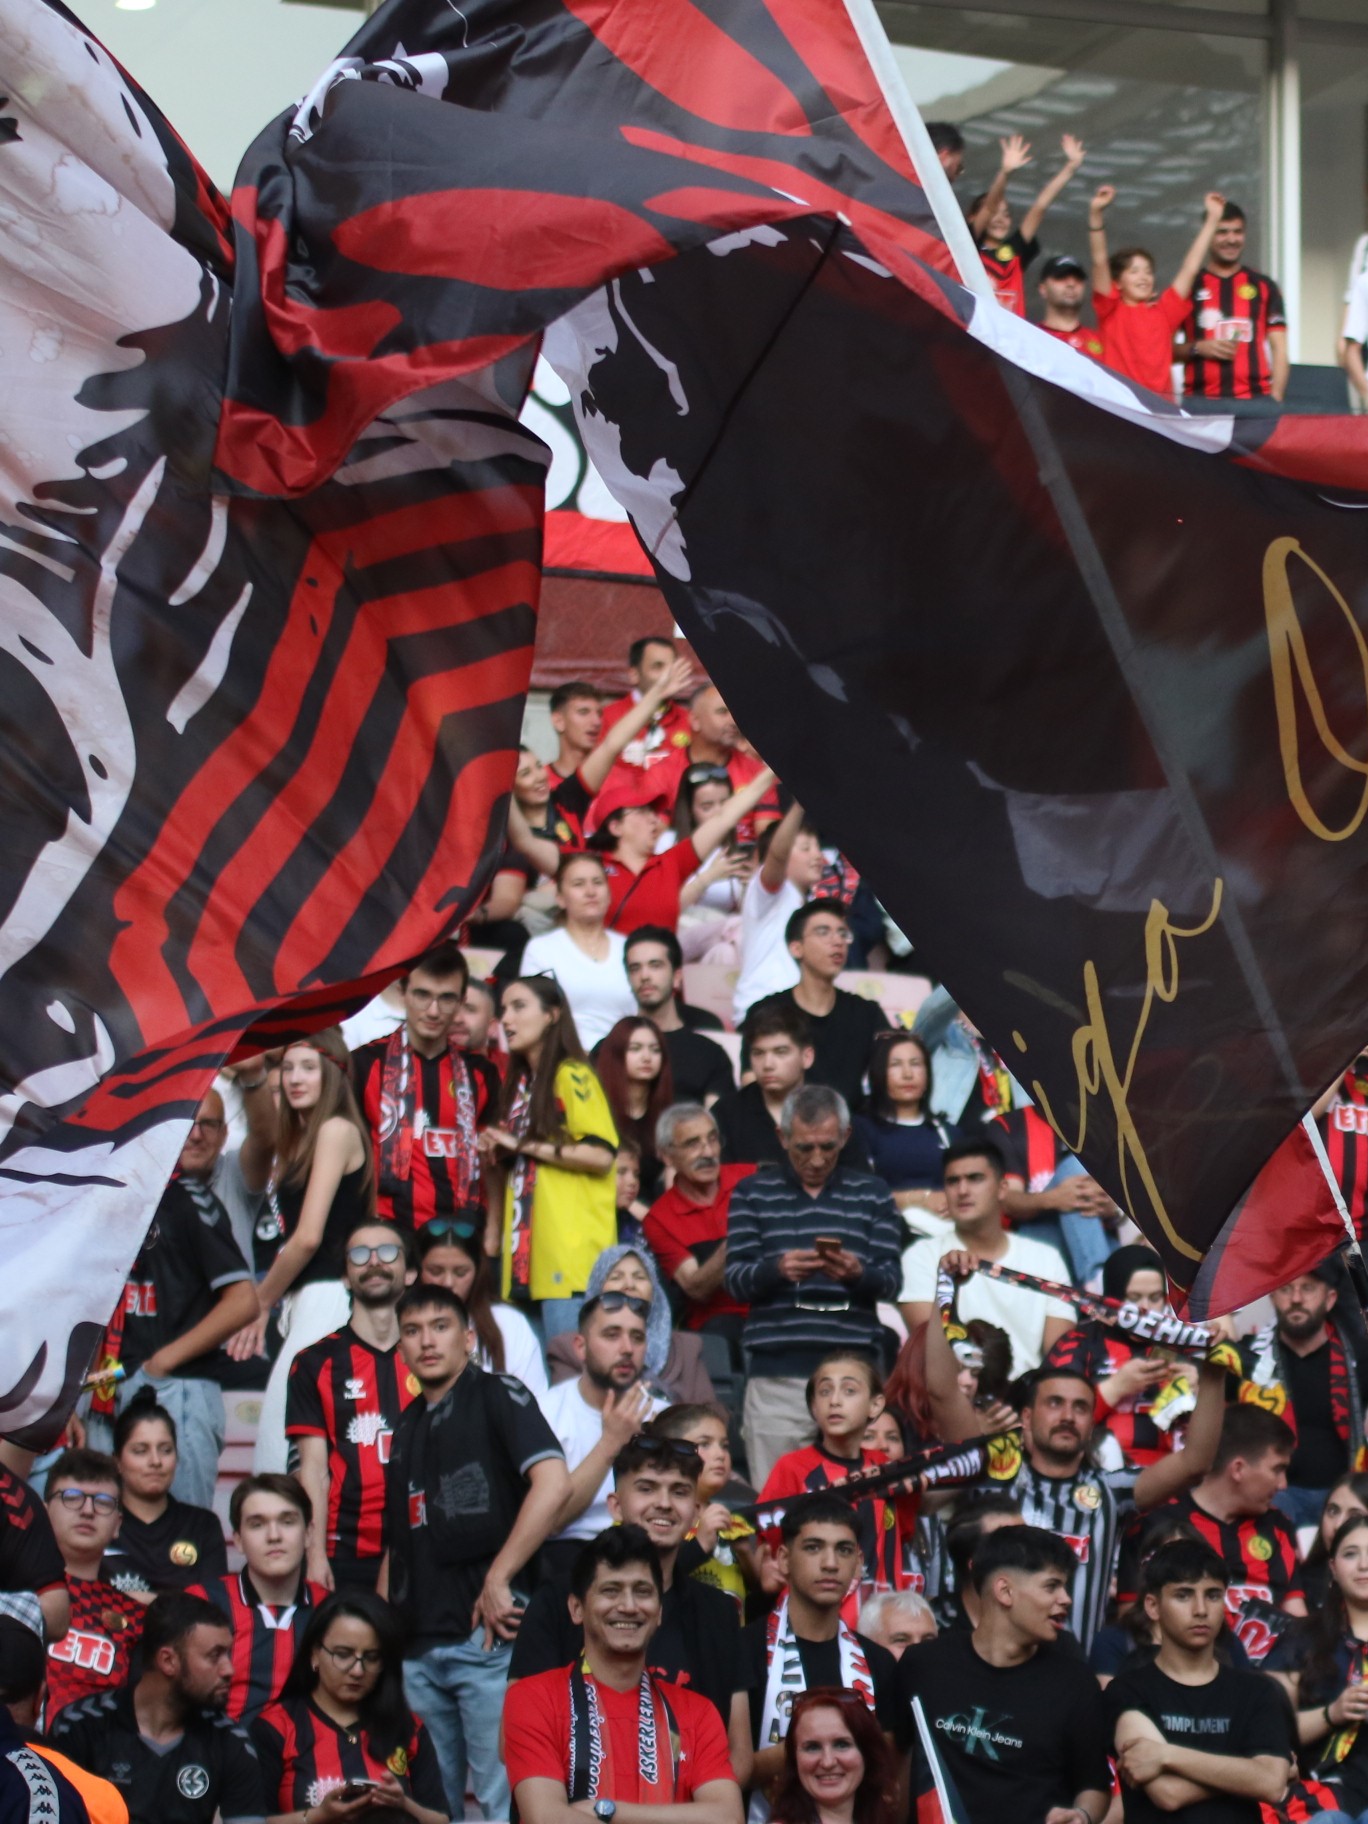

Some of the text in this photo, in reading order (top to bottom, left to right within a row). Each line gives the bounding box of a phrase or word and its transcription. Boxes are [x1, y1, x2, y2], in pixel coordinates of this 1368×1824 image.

[935, 1718, 1023, 1749] Calvin Klein Jeans
